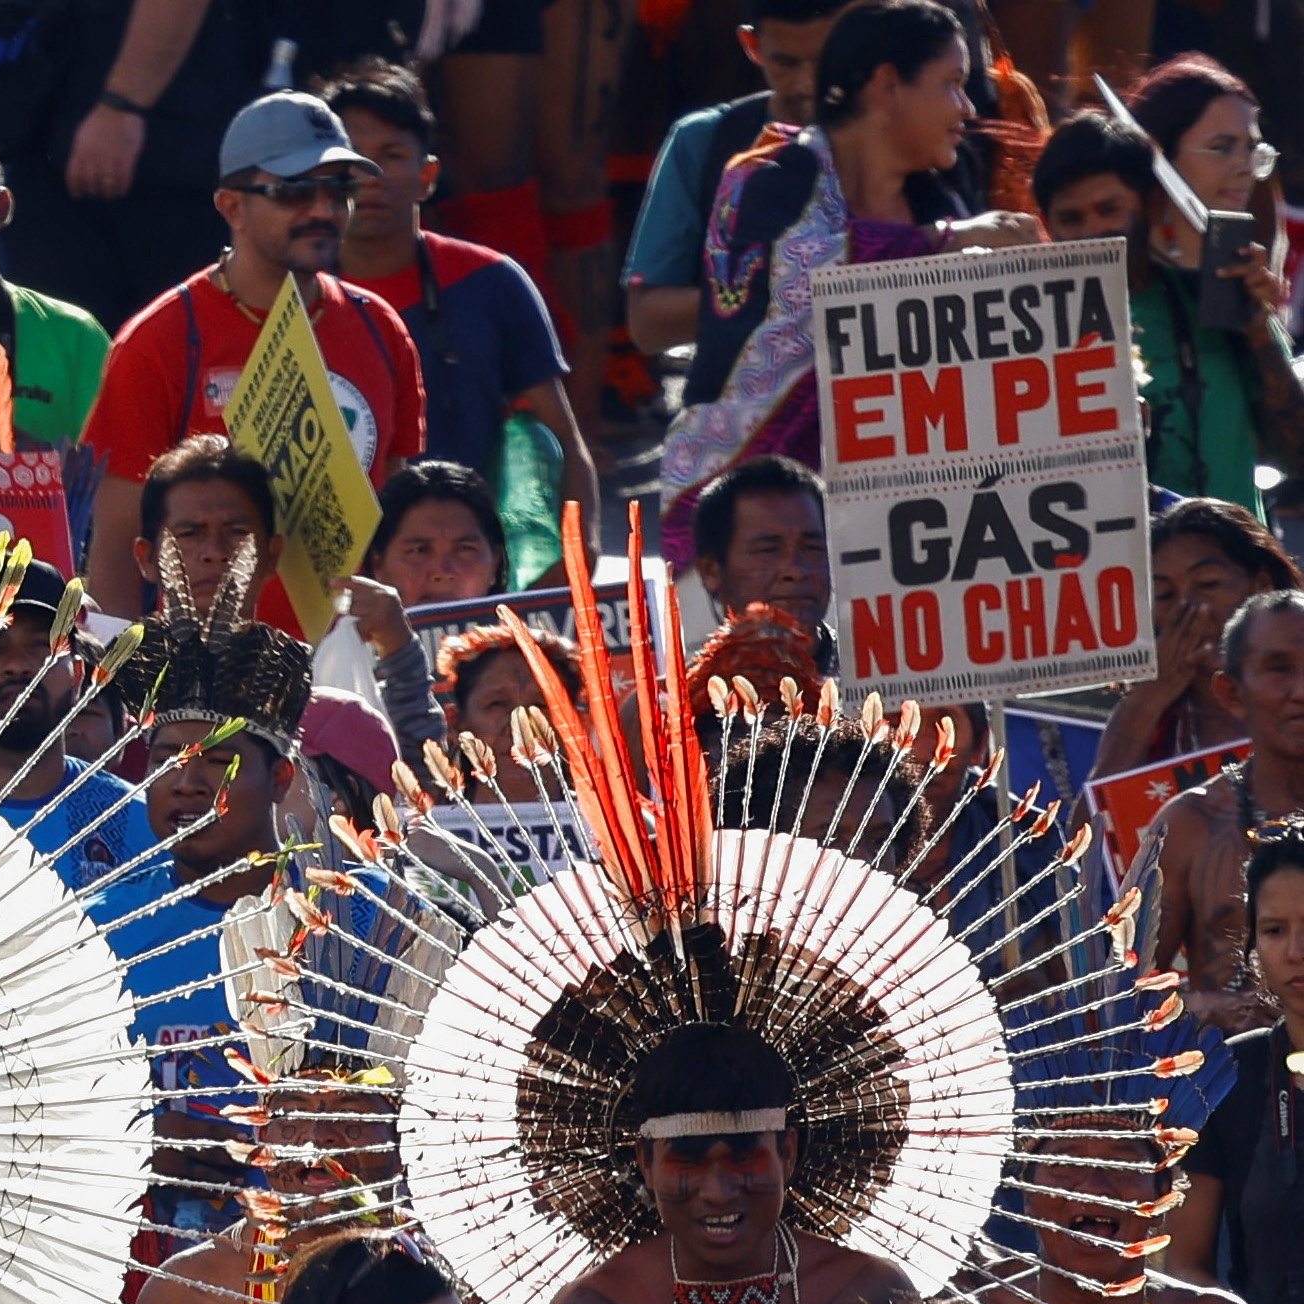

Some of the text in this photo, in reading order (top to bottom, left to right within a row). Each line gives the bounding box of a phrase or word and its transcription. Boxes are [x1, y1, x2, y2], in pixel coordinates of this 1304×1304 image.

[825, 276, 1115, 374] FLORESTA
[831, 331, 1120, 464] EM PÉ
[851, 554, 1136, 679] NO CHÃO
